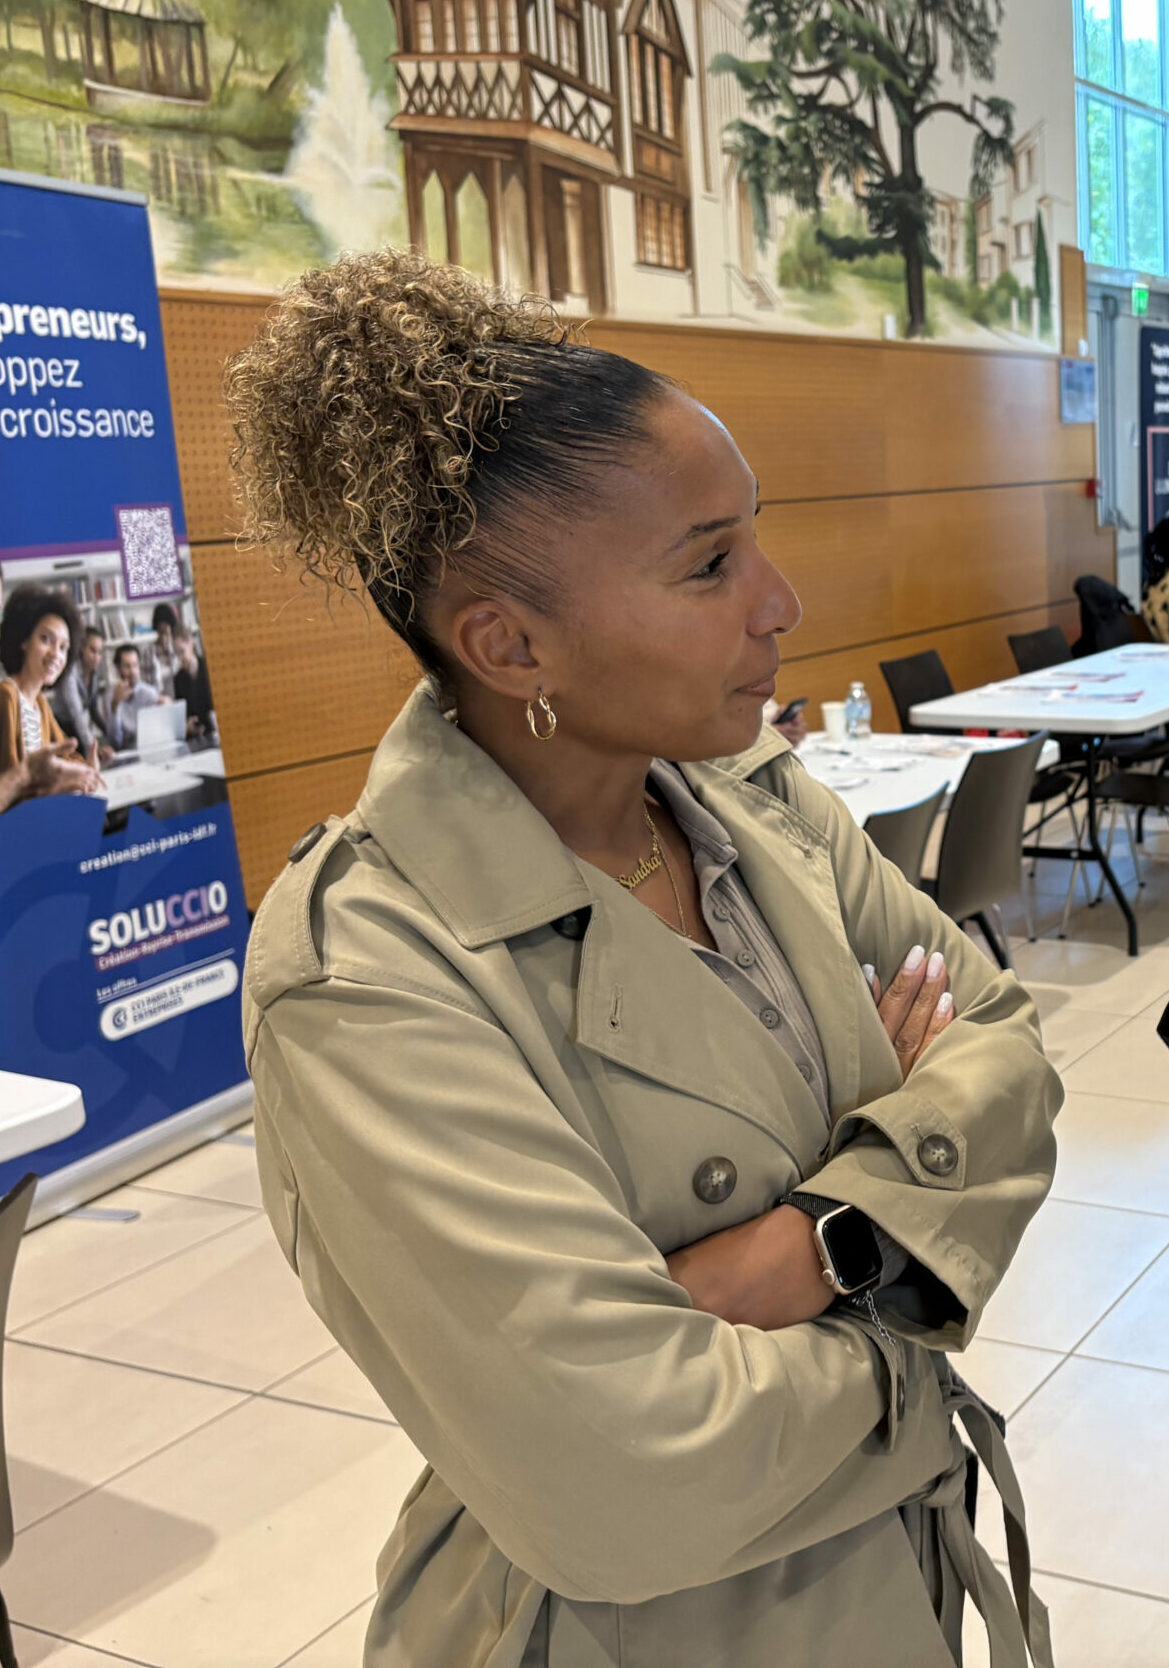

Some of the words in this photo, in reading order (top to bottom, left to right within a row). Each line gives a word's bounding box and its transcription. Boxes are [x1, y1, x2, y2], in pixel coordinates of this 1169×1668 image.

[1, 398, 155, 438] croissance
[619, 855, 662, 889] Sandra
[89, 879, 228, 956] SOLUCCIO
